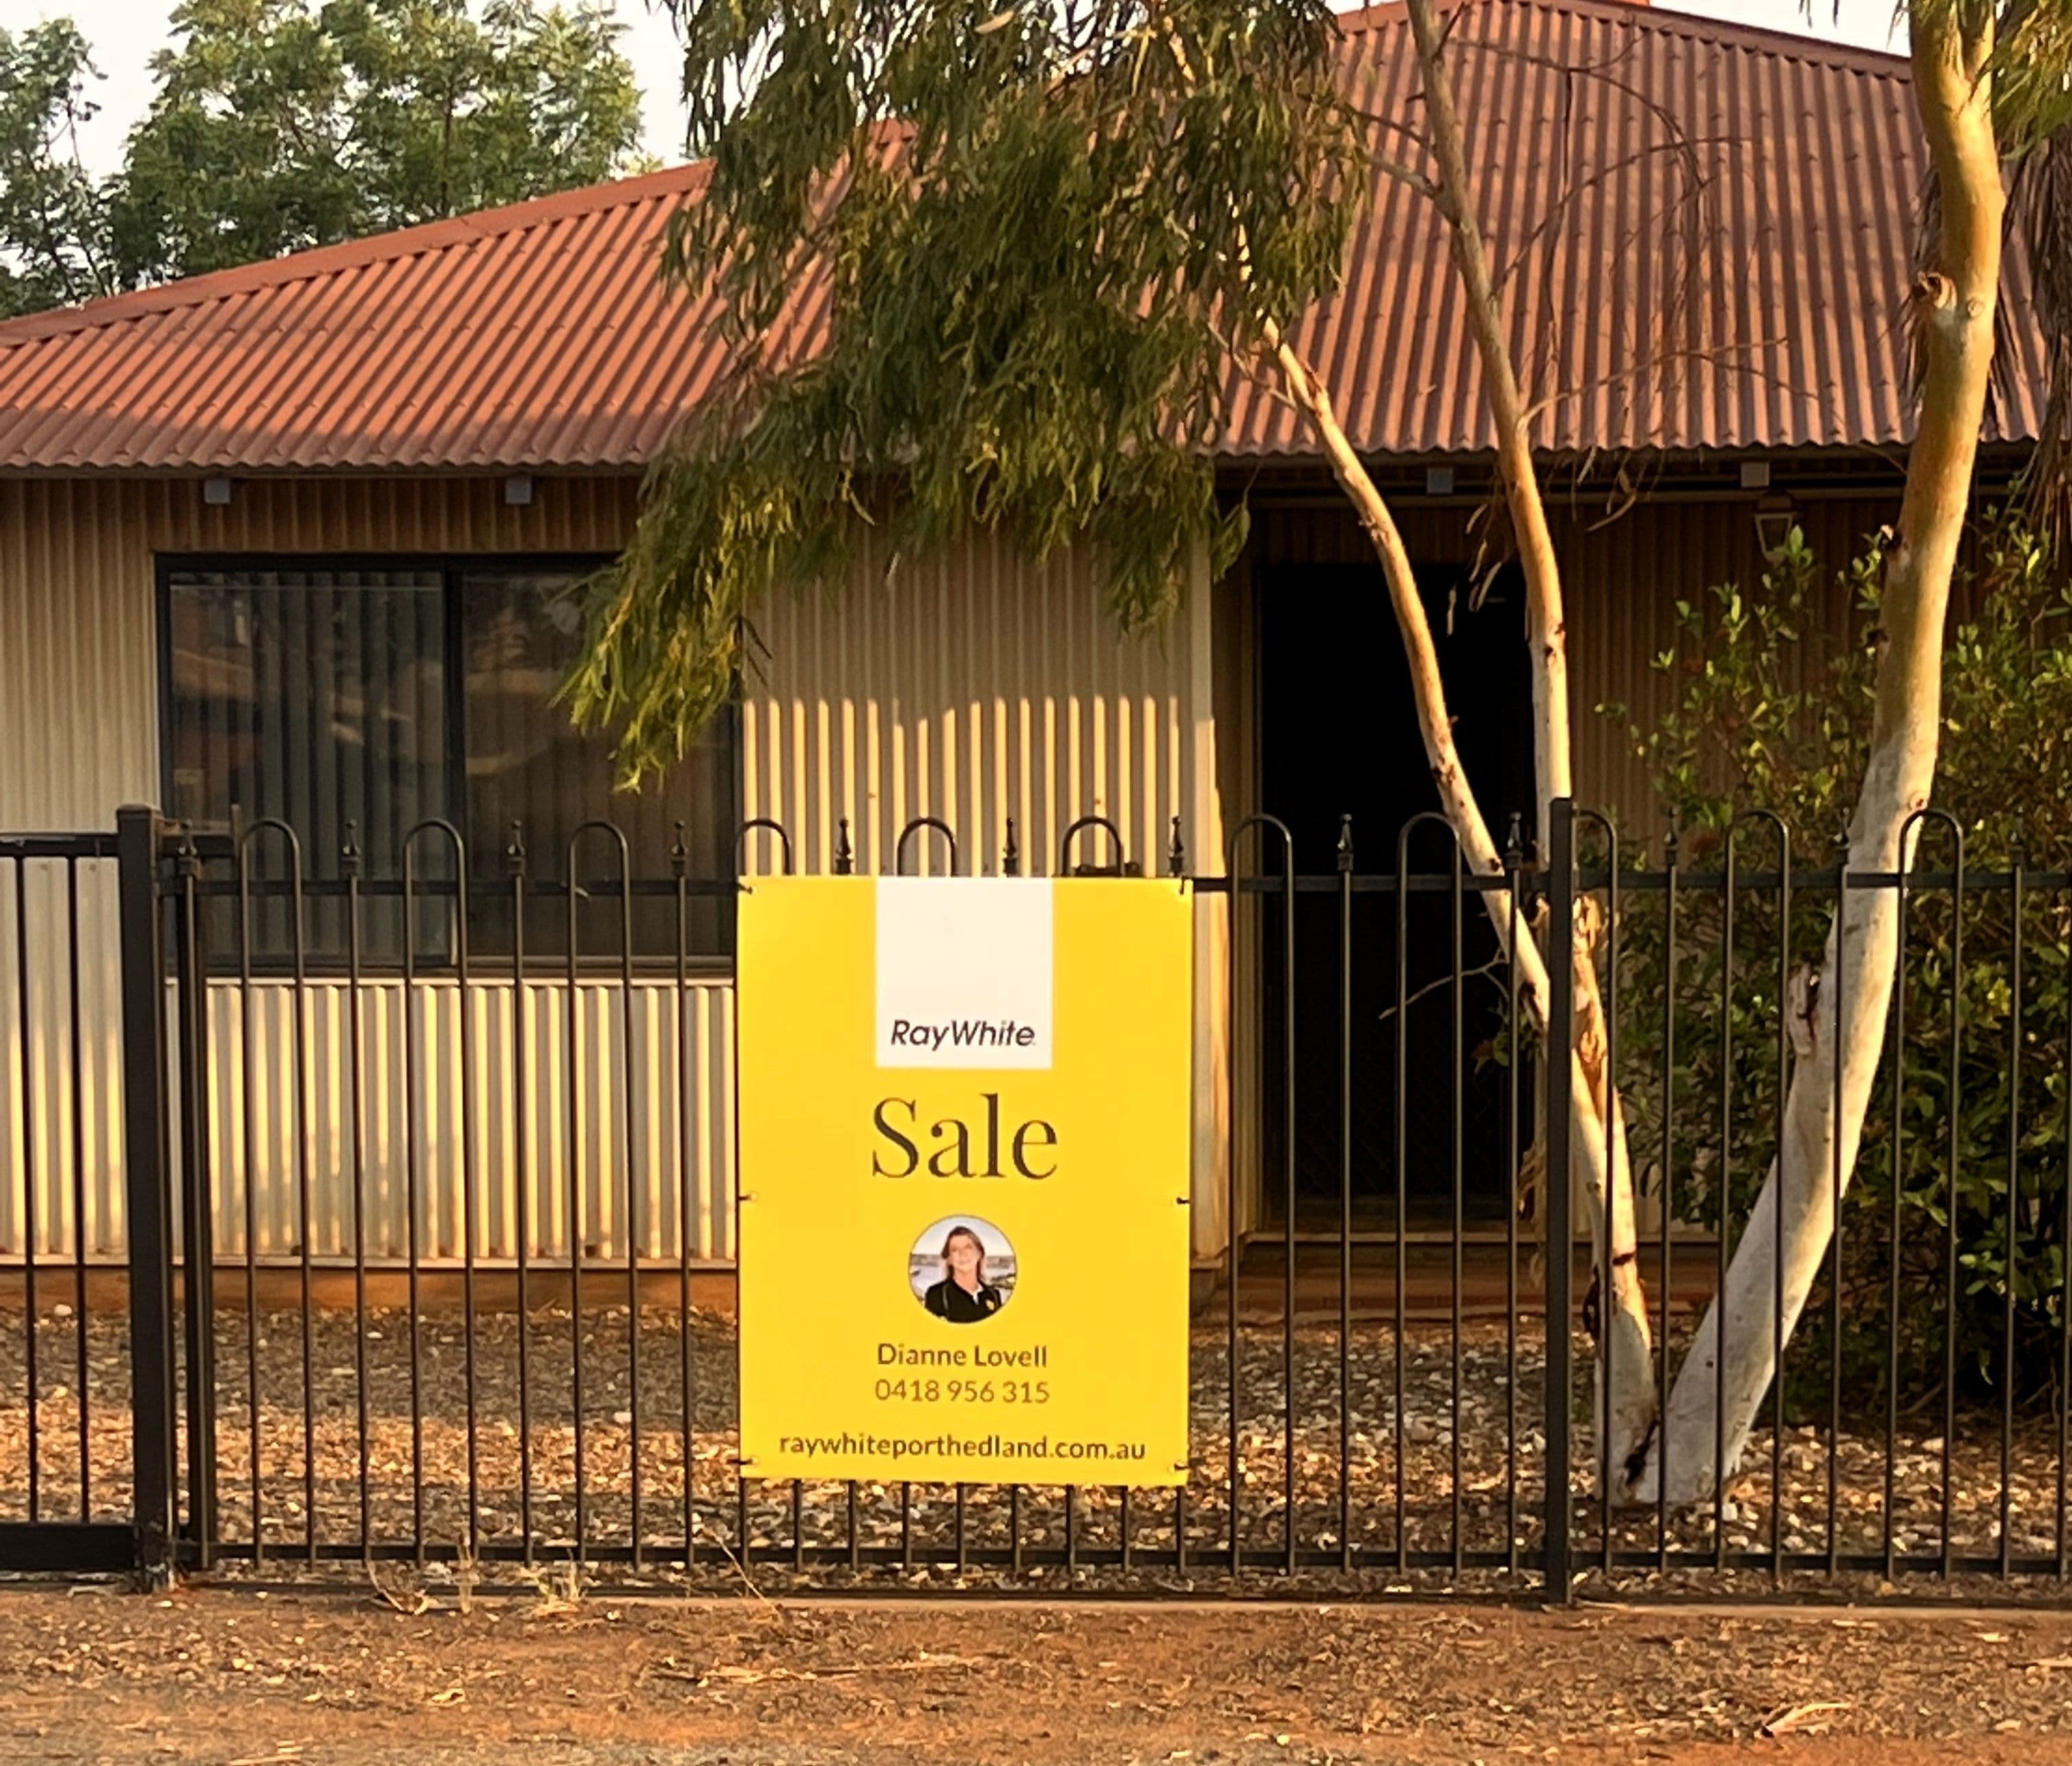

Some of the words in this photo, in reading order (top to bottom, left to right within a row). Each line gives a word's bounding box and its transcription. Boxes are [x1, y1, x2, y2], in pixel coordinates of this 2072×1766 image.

[872, 1092, 1057, 1181] Sale
[877, 1343, 967, 1366] Dianne
[974, 1345, 1047, 1369] Lovell
[875, 1378, 939, 1403] 0418
[947, 1379, 995, 1404] 956
[1002, 1380, 1050, 1405] 315
[778, 1432, 1146, 1461] raywhiteporthedland.com.au
